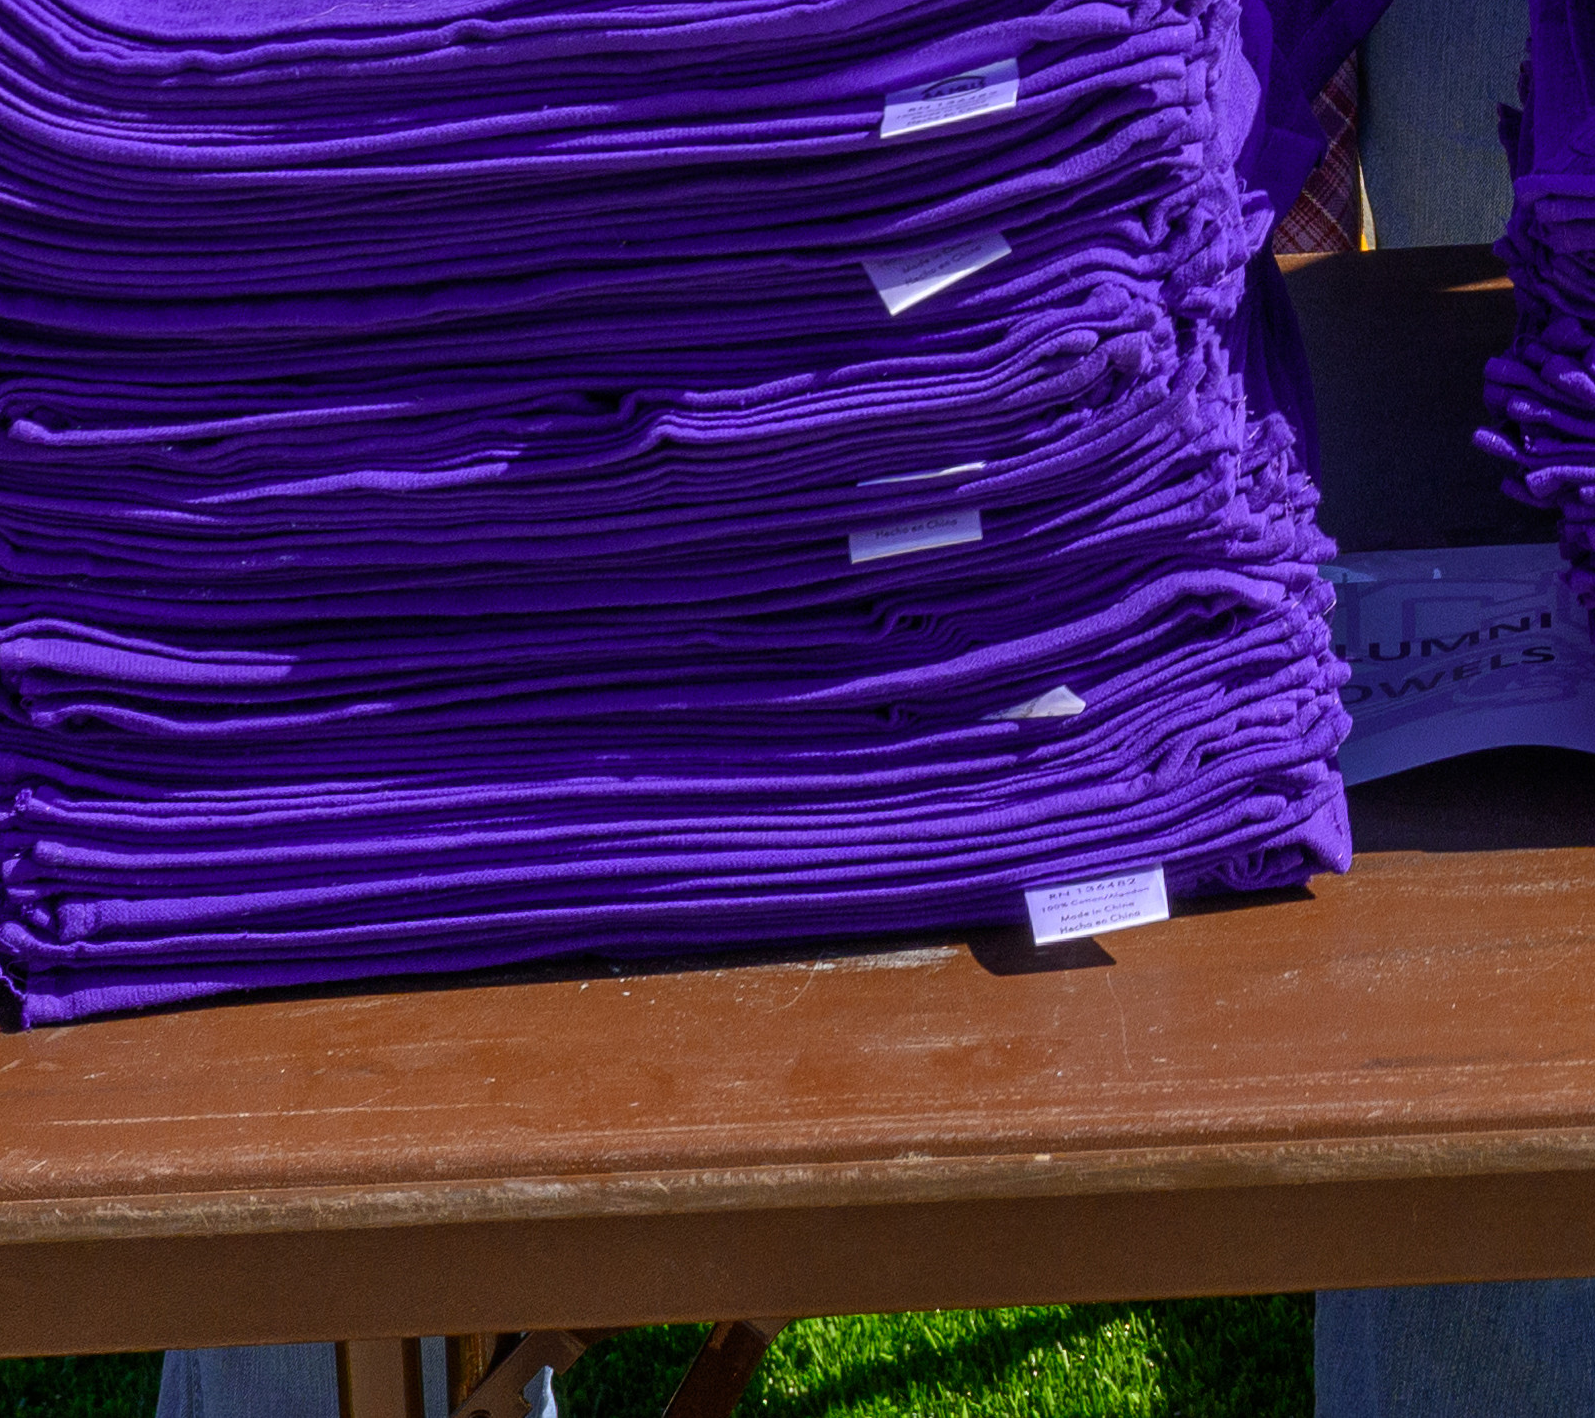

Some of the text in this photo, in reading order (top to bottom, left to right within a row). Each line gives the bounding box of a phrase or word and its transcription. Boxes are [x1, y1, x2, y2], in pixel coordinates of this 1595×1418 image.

[1335, 611, 1552, 663] LUMNI
[1341, 645, 1556, 706] OWELS
[1059, 910, 1141, 935] Hecho en China
[1060, 911, 1090, 923] Made
[1104, 901, 1135, 913] China
